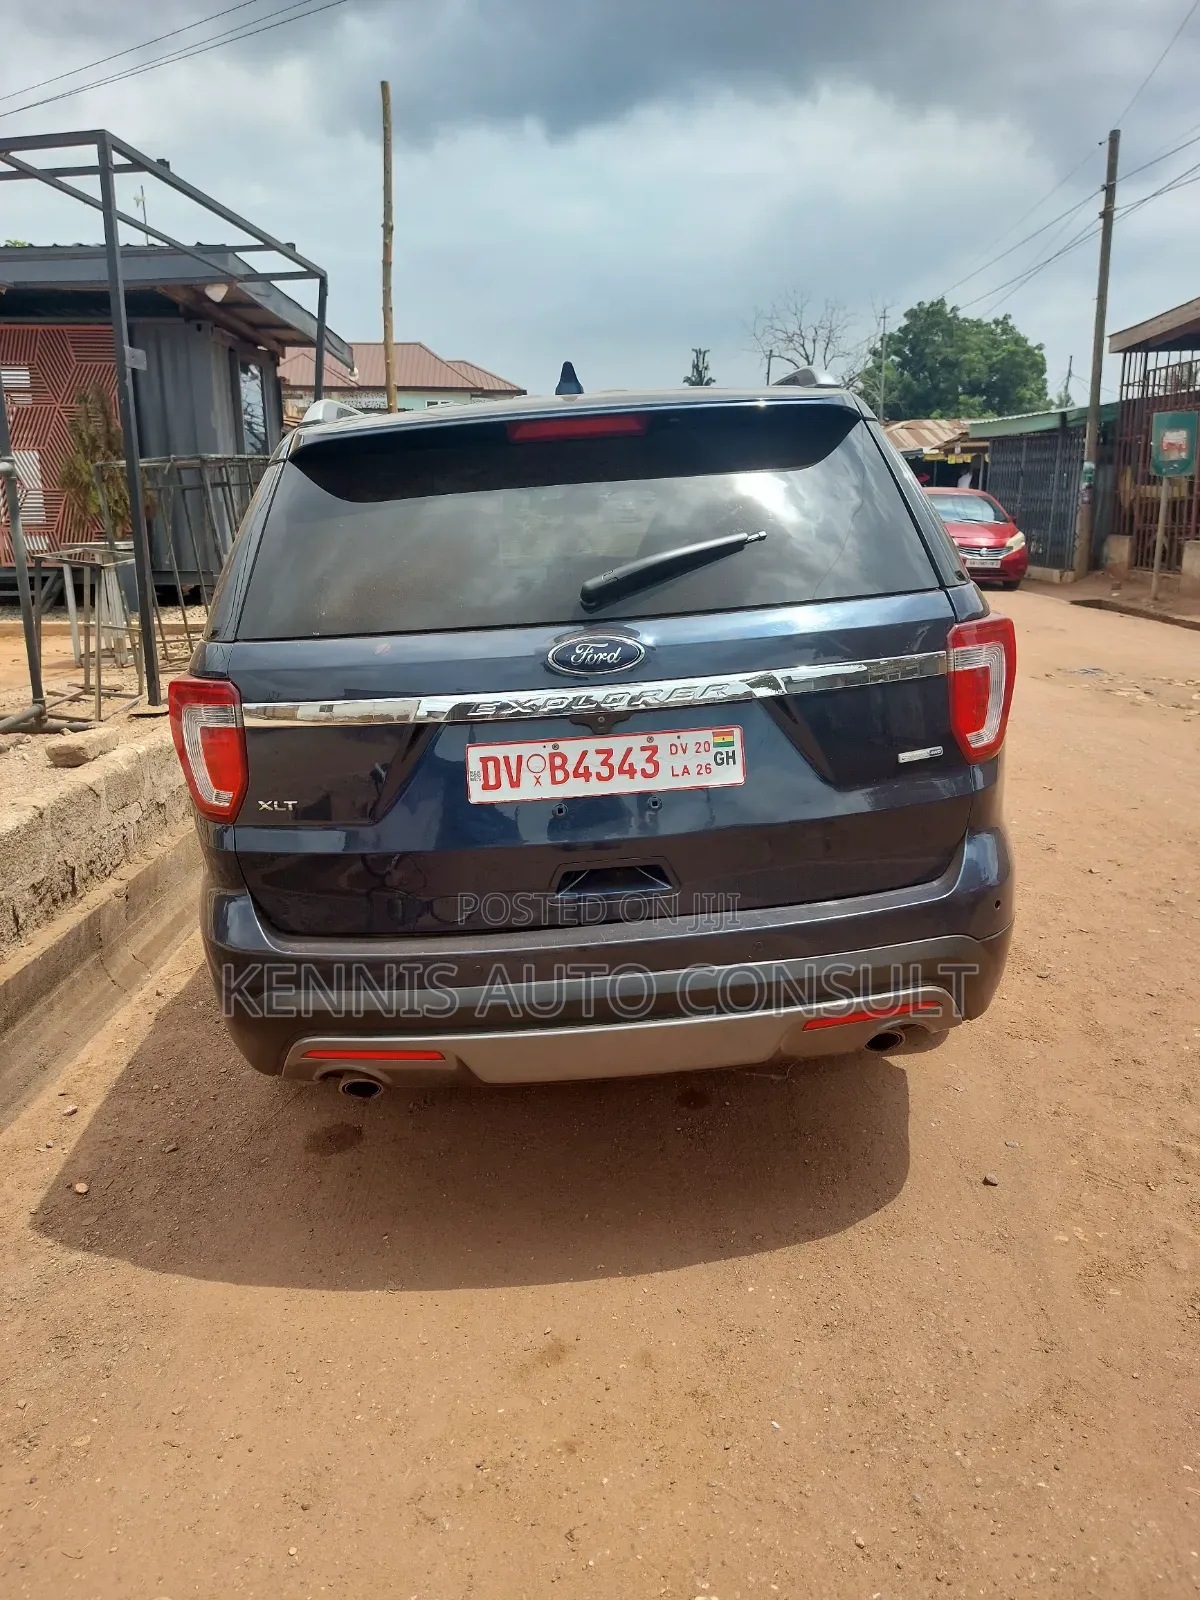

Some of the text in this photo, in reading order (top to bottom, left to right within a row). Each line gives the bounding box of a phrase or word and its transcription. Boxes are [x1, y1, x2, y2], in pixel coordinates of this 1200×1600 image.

[570, 642, 623, 666] Ford
[467, 682, 734, 716] EXPLORER
[669, 740, 711, 756] DV 20
[713, 750, 736, 767] GH
[479, 754, 523, 791] DV
[549, 745, 660, 786] B4343
[671, 763, 712, 778] LA 26
[257, 800, 298, 811] XLT
